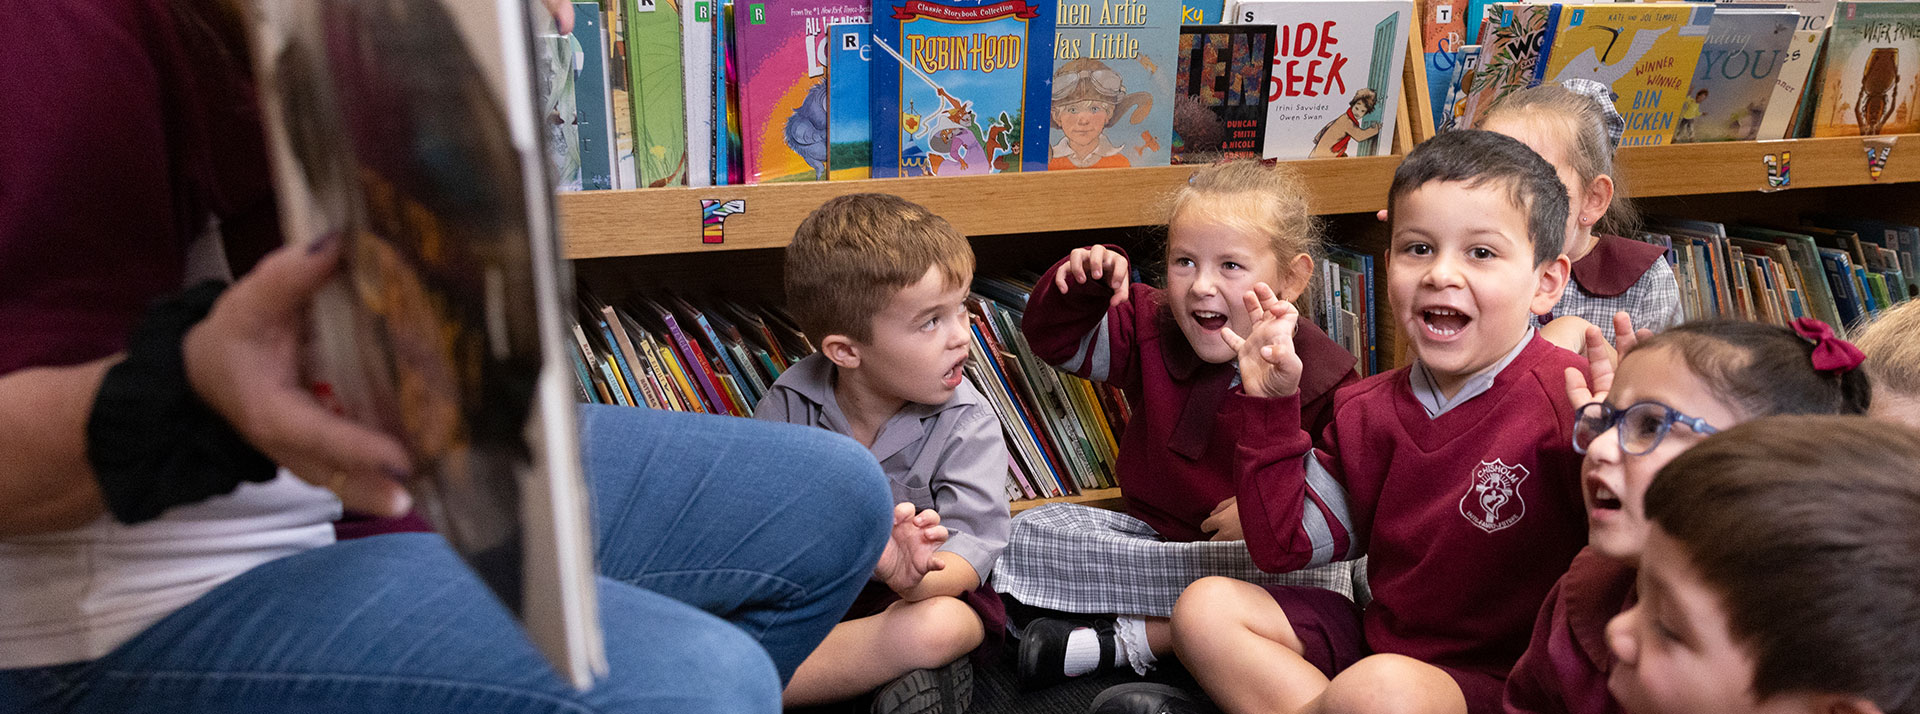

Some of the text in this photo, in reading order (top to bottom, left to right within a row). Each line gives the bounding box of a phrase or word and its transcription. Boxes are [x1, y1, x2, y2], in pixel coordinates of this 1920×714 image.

[917, 3, 942, 14] Classic
[980, 4, 1013, 17] Collection
[1056, 0, 1147, 26] hen Artie
[1244, 11, 1255, 23] S
[1440, 10, 1449, 21] T
[806, 17, 821, 36] ALL
[845, 35, 857, 48] R
[1089, 32, 1139, 60] Little
[1274, 20, 1338, 59] IDE
[1467, 57, 1475, 68] T
[1635, 56, 1674, 77] WINNER
[1702, 49, 1781, 79] YOU
[1647, 74, 1682, 90] WINNER
[1632, 90, 1662, 110] BIN
[1227, 120, 1257, 128] DUNCAN
[1233, 130, 1256, 138] SMITH
[1229, 140, 1255, 149] NICOLE
[1477, 465, 1519, 484] CHISHOLM
